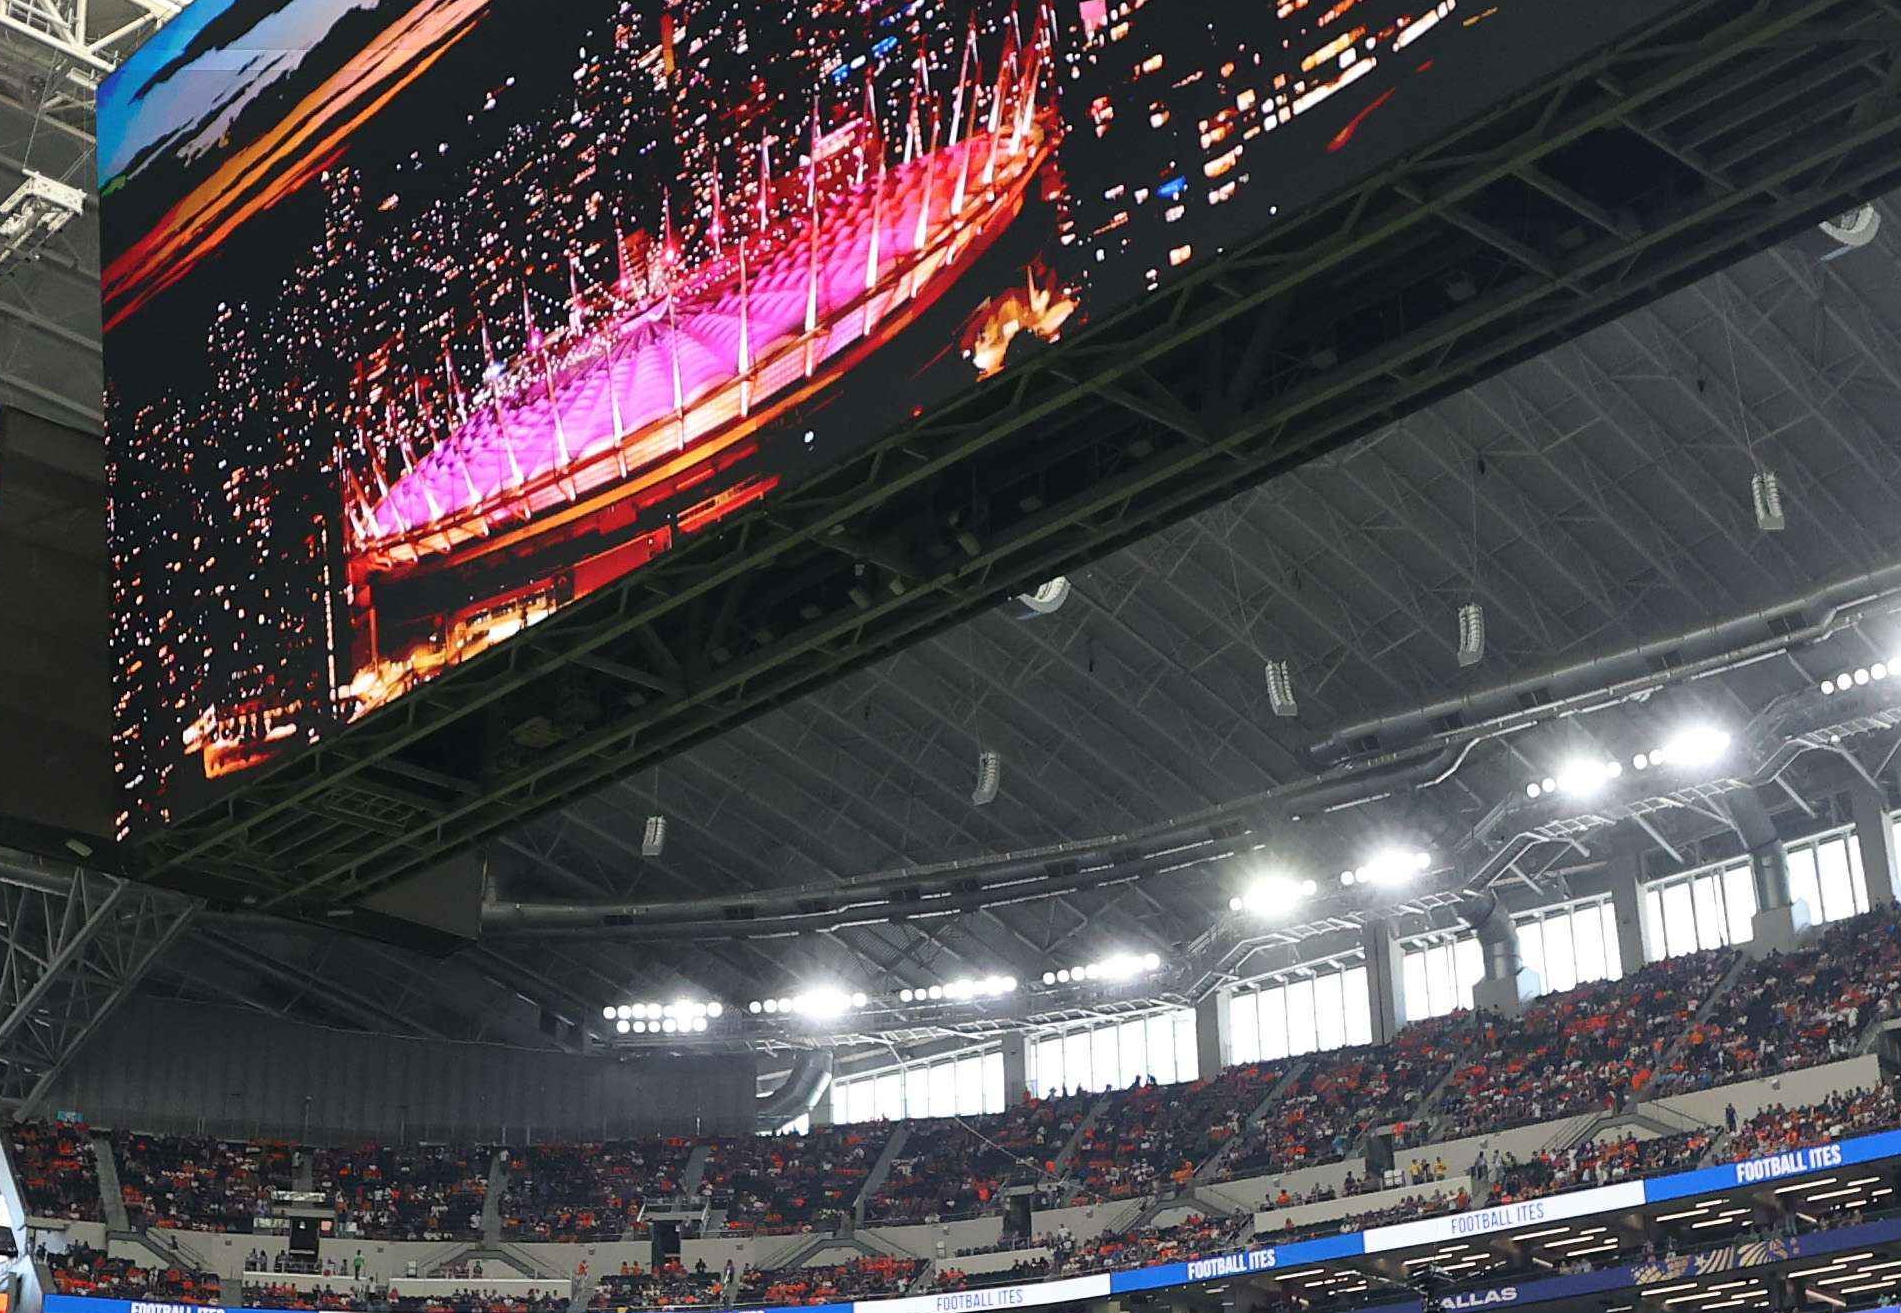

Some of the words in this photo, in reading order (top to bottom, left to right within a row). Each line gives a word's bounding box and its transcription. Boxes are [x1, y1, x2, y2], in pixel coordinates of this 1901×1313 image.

[1736, 1152, 1807, 1182] FOOTBALL
[1451, 1213, 1512, 1234] FOOTBALL
[1187, 1253, 1247, 1280] FOOTBALL
[937, 1292, 994, 1312] FOOTBALL
[1440, 1287, 1518, 1311] ALLAS
